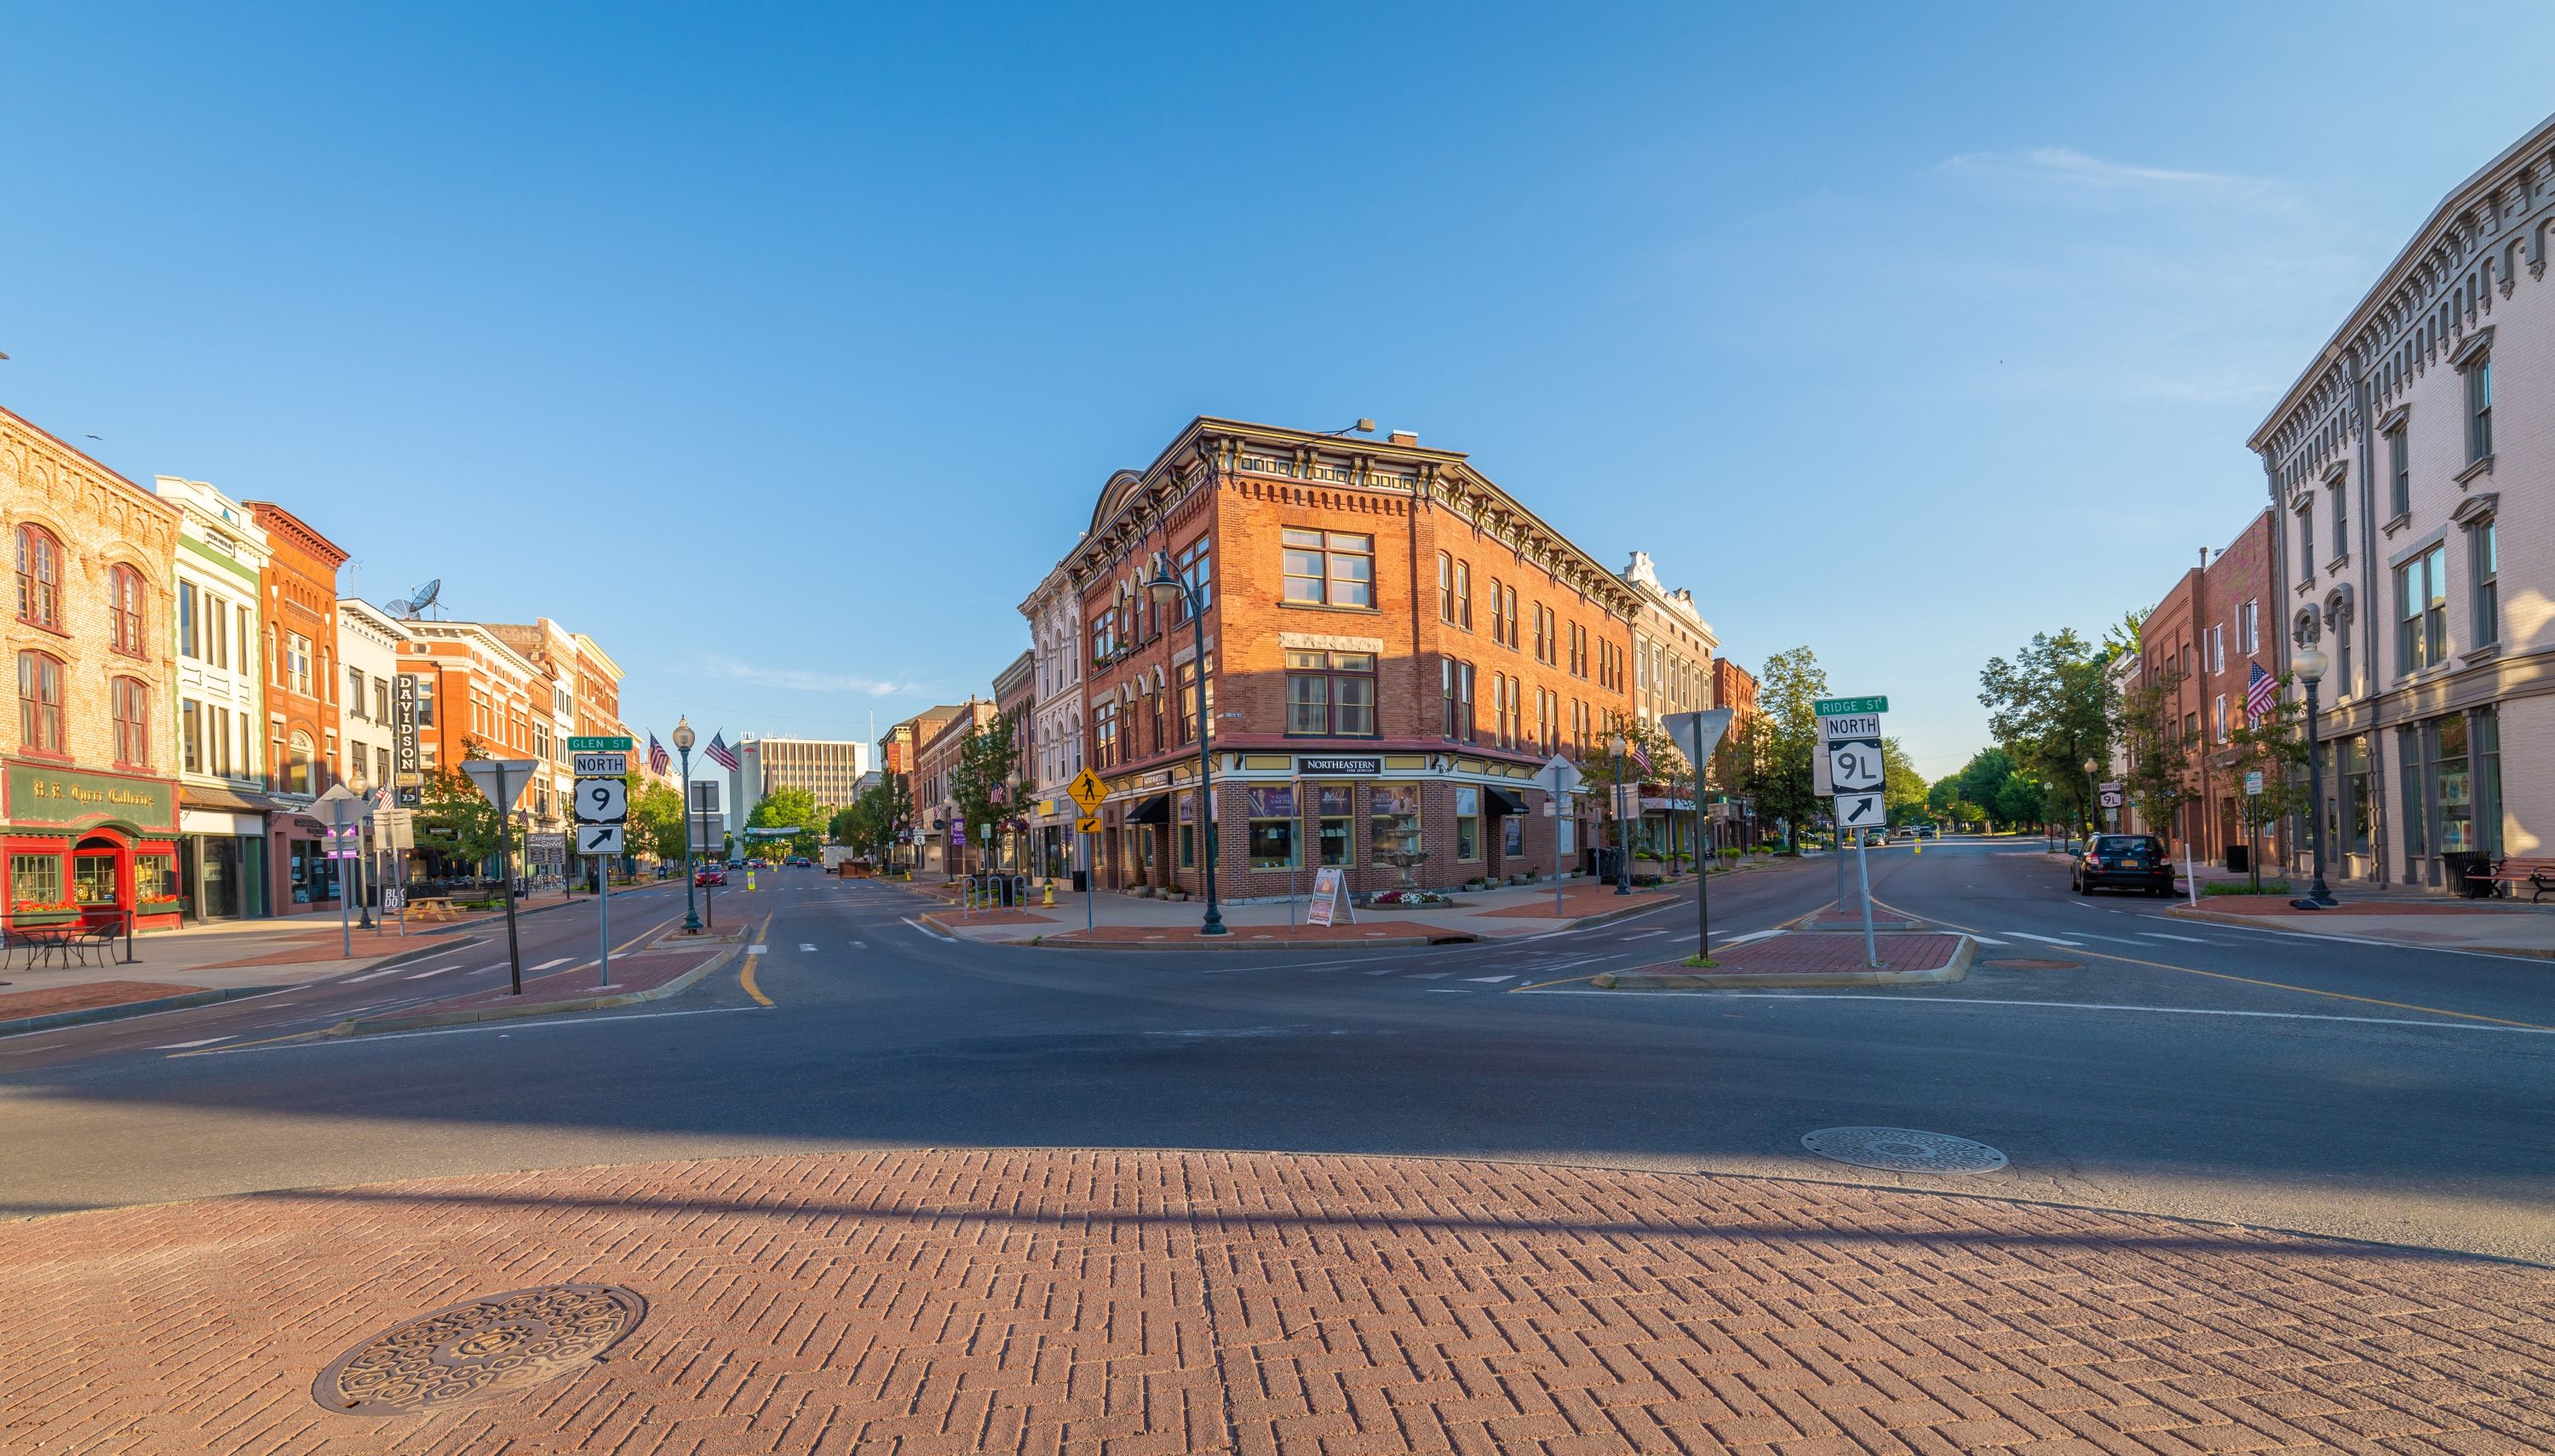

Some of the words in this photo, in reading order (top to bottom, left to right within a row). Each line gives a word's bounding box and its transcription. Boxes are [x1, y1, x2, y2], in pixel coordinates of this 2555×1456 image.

[1823, 701, 1858, 714] RIDGE
[1866, 699, 1880, 709] ST
[399, 677, 415, 770] DAVIDSON
[1829, 718, 1876, 734] NORTH
[572, 739, 604, 748] GLEN
[612, 739, 626, 748] ST
[577, 758, 623, 771] NORTH
[1307, 760, 1375, 769] NORTHEASTERN
[1837, 752, 1877, 780] 9L
[108, 788, 155, 806] Galleries
[591, 787, 611, 811] 9
[2104, 795, 2119, 805] 9L
[530, 834, 562, 842] Exchange
[540, 840, 562, 849] Street
